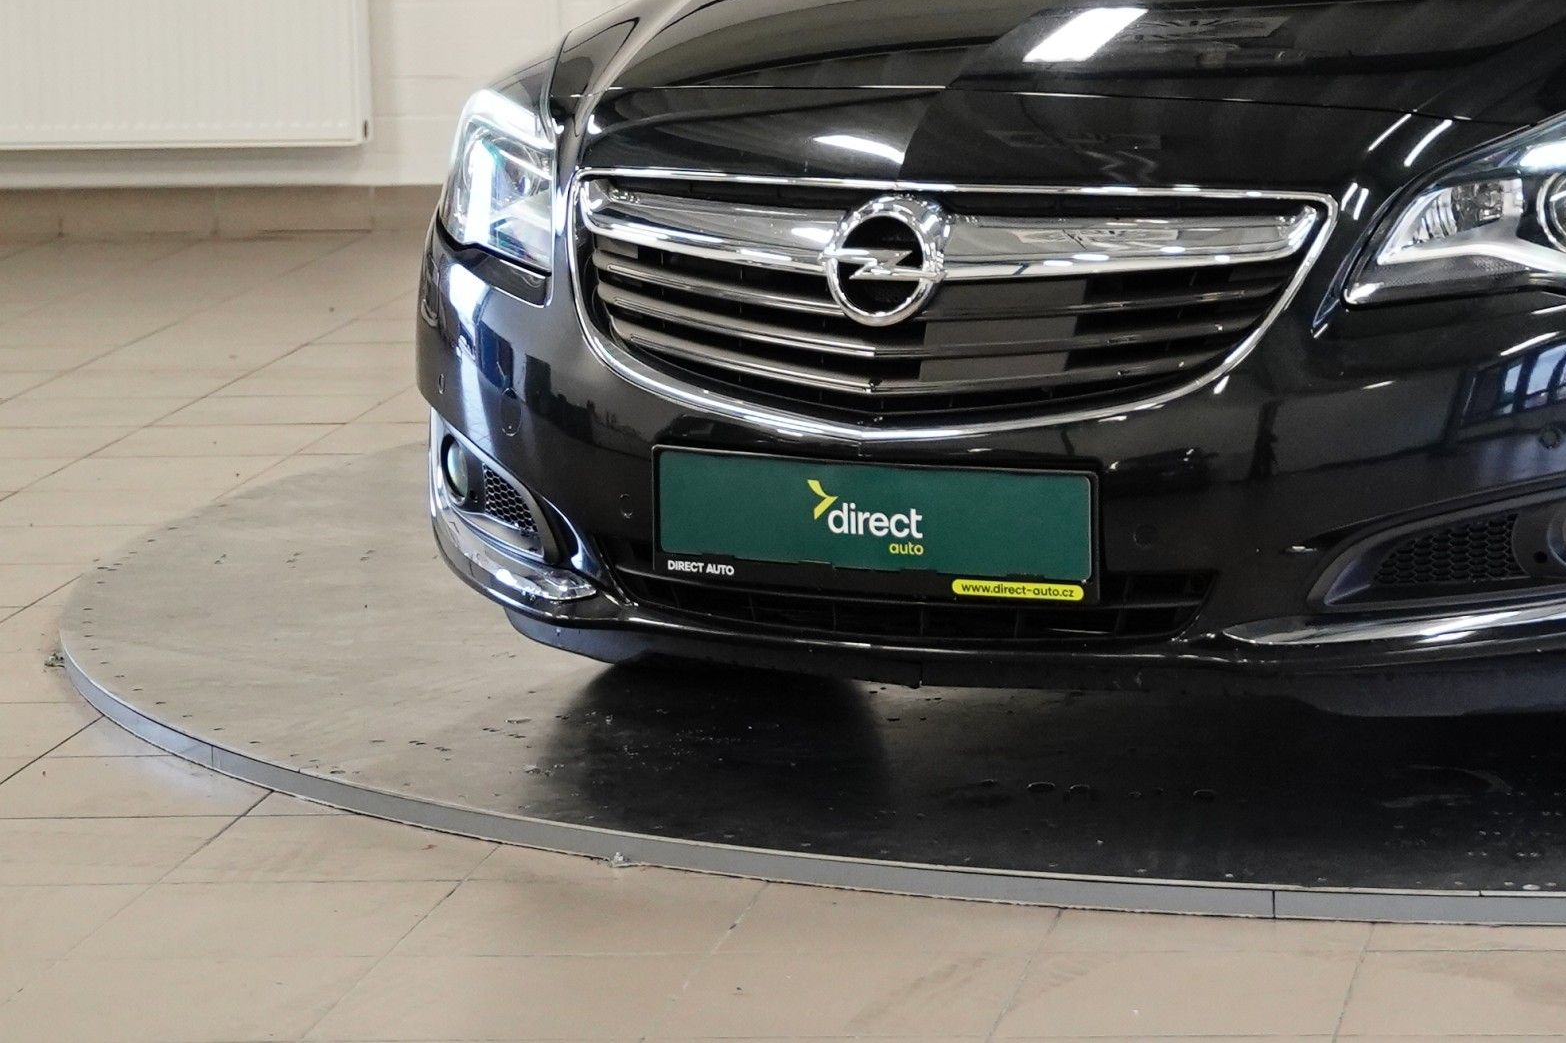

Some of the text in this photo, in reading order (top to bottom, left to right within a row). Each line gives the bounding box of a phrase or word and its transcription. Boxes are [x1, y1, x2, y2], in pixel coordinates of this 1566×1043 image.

[827, 502, 923, 539] direct
[889, 541, 924, 556] auto
[667, 559, 735, 576] DIRECT AUTO
[961, 582, 1075, 598] www.direct-auto.cz
